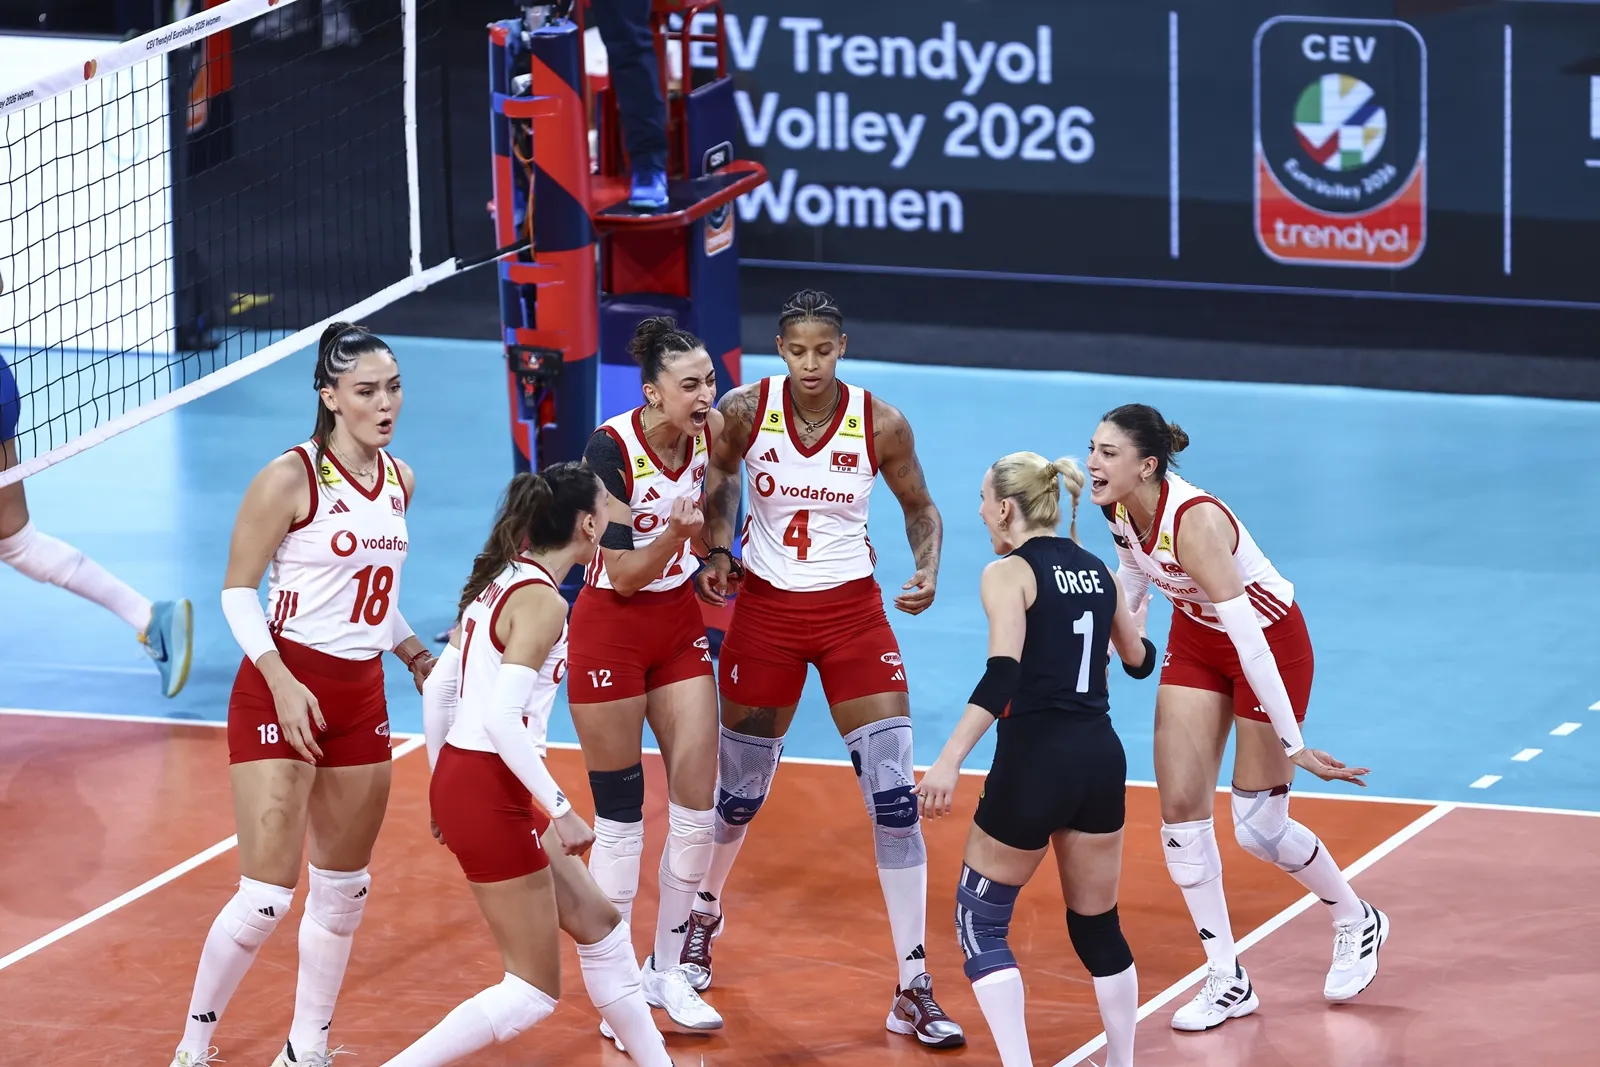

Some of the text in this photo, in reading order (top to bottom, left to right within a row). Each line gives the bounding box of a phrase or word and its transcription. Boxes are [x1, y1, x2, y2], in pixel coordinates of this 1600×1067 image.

[779, 17, 1052, 96] Trendyol
[1302, 34, 1376, 63] CEV
[733, 89, 1096, 170] Volley 2026
[1283, 157, 1362, 203] EuroVolley
[735, 168, 964, 233] Women
[1274, 218, 1409, 256] trendyol
[836, 465, 853, 473] TUR
[780, 485, 855, 504] vodafone
[782, 509, 812, 561] 4
[349, 564, 394, 626] 18
[1053, 565, 1104, 594] ÖRGE
[1073, 610, 1094, 693] 1
[587, 668, 613, 688] 12
[730, 663, 739, 684] 4
[257, 723, 279, 745] 18
